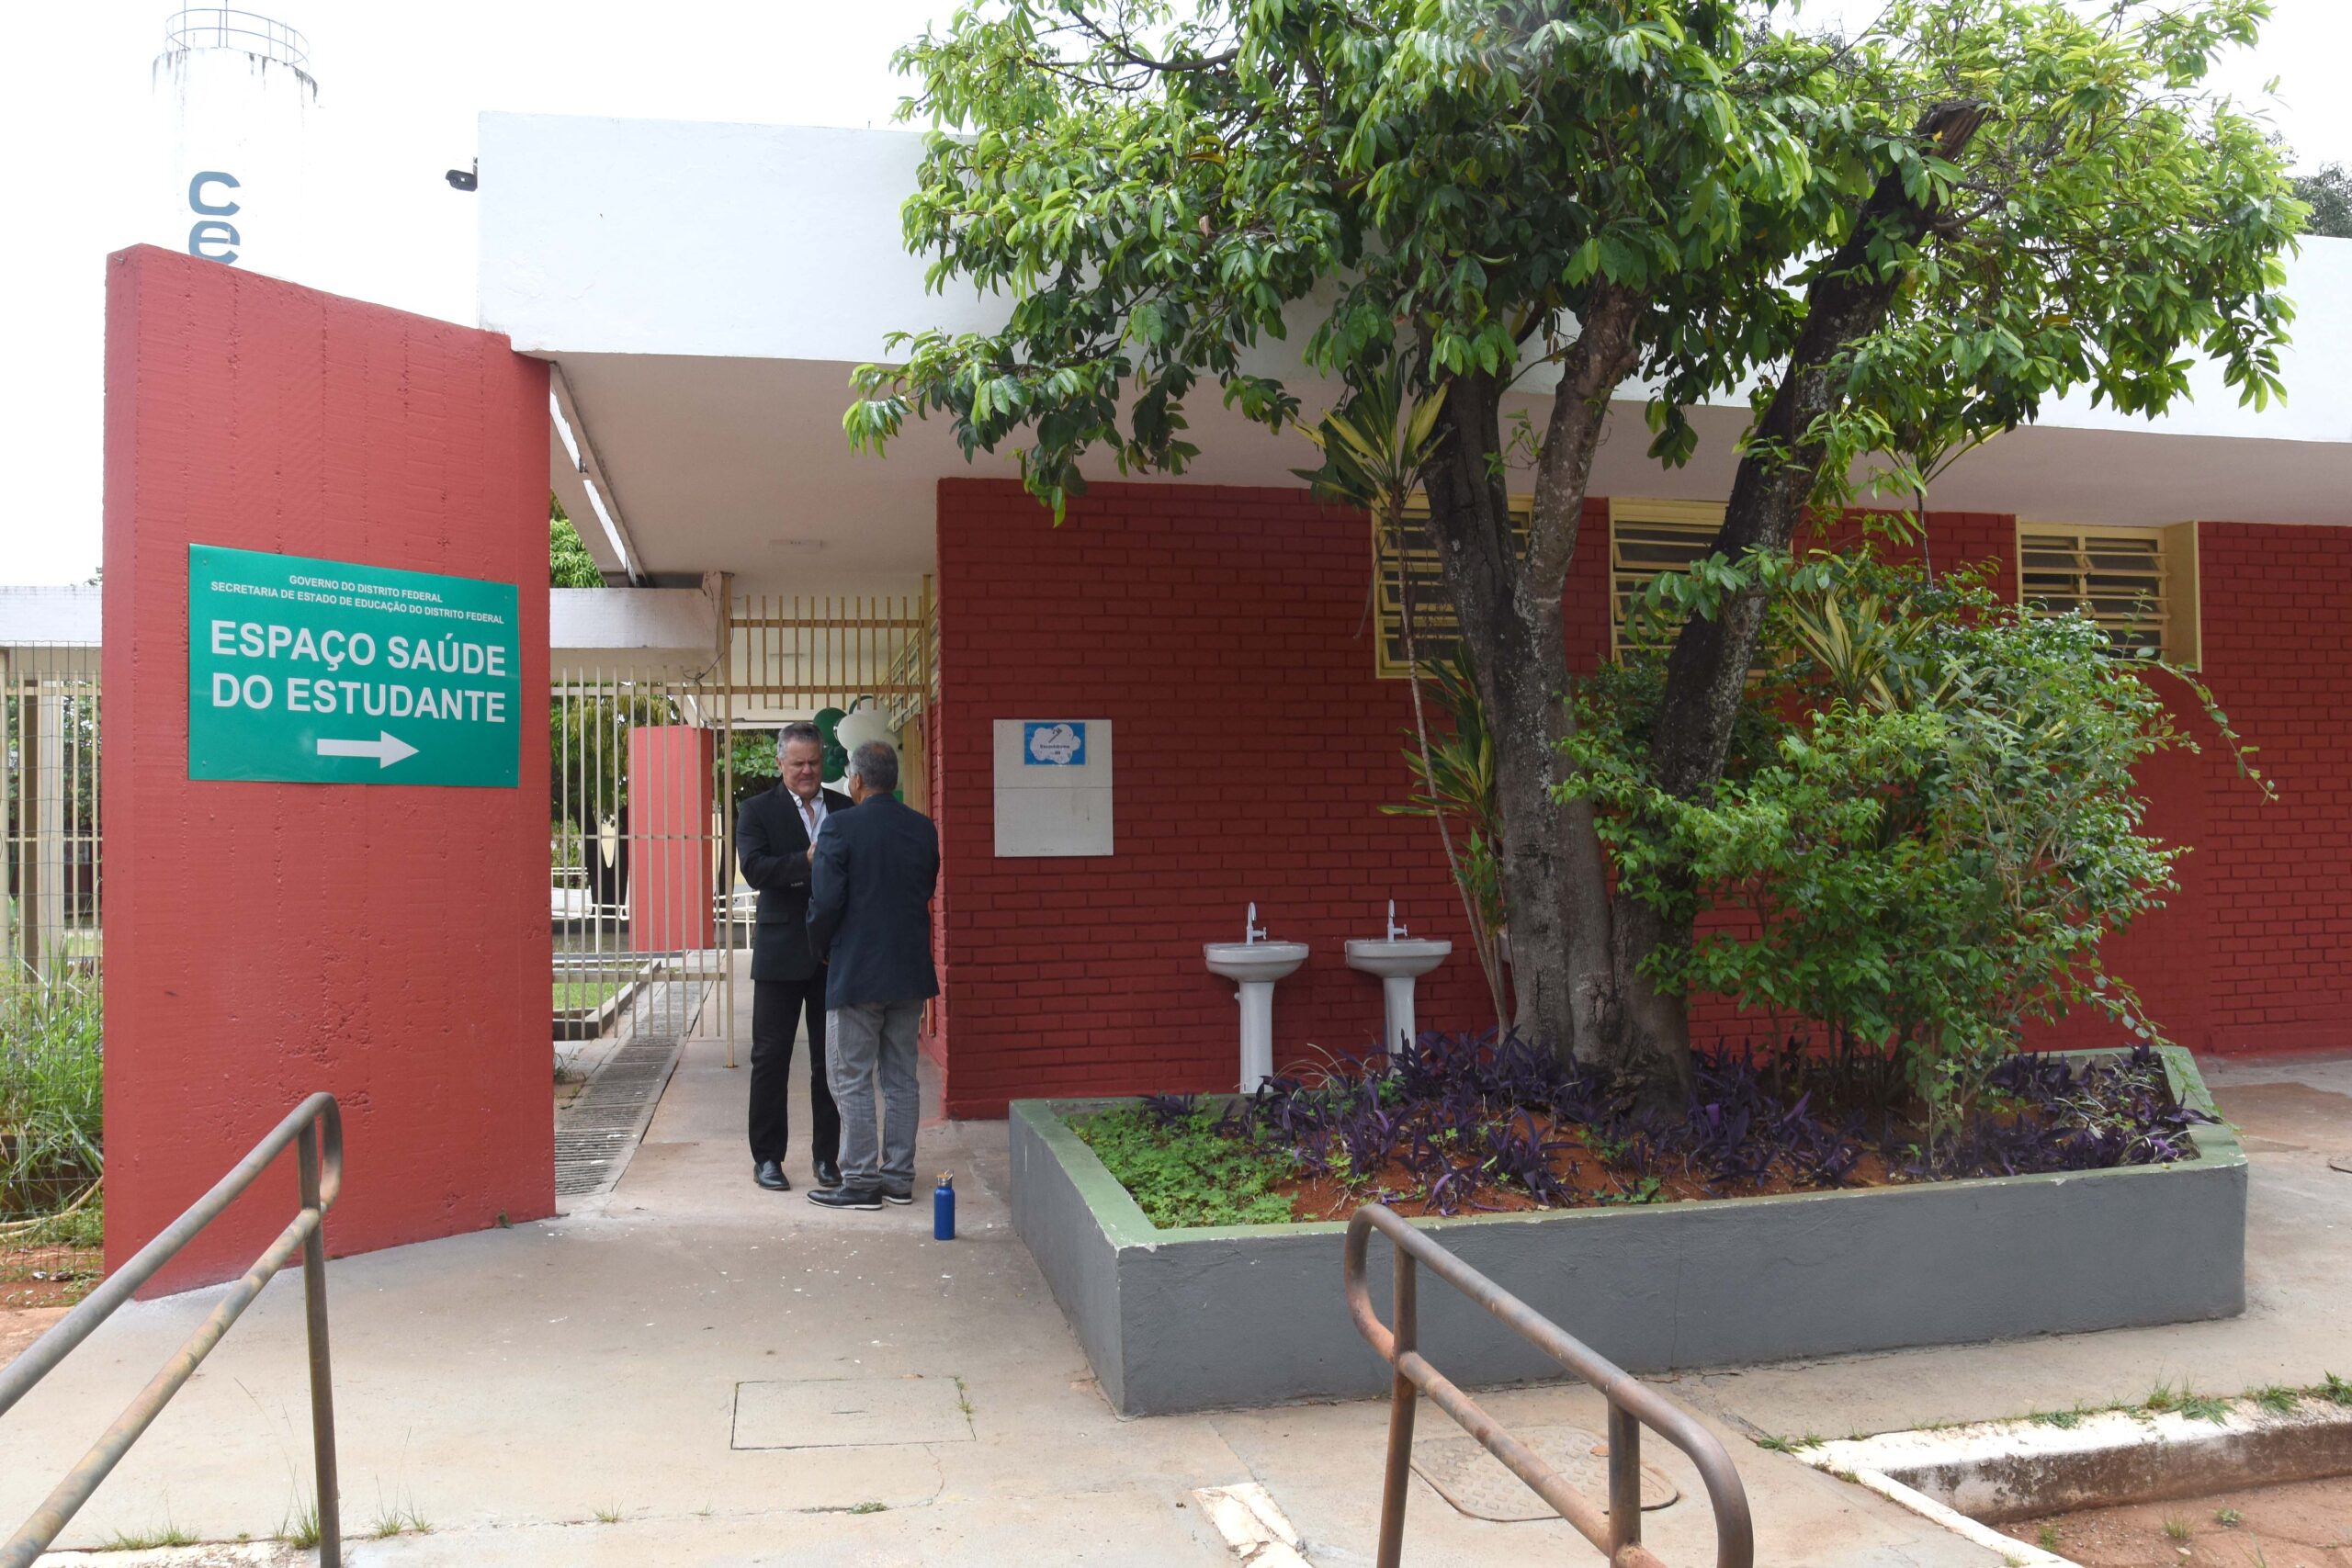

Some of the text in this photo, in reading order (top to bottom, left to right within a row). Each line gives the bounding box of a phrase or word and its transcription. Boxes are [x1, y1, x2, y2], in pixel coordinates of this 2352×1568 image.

[210, 581, 504, 624] SECRETARIA DE ESTADO DE EDUCAÇÃO DO DISTRITO FEDERAL
[289, 575, 443, 603] GOVERNO DO DISTRITO FEDERAL
[211, 619, 506, 677] ESPAÇO SAÚDE
[212, 672, 505, 723] DO ESTUDANTE
